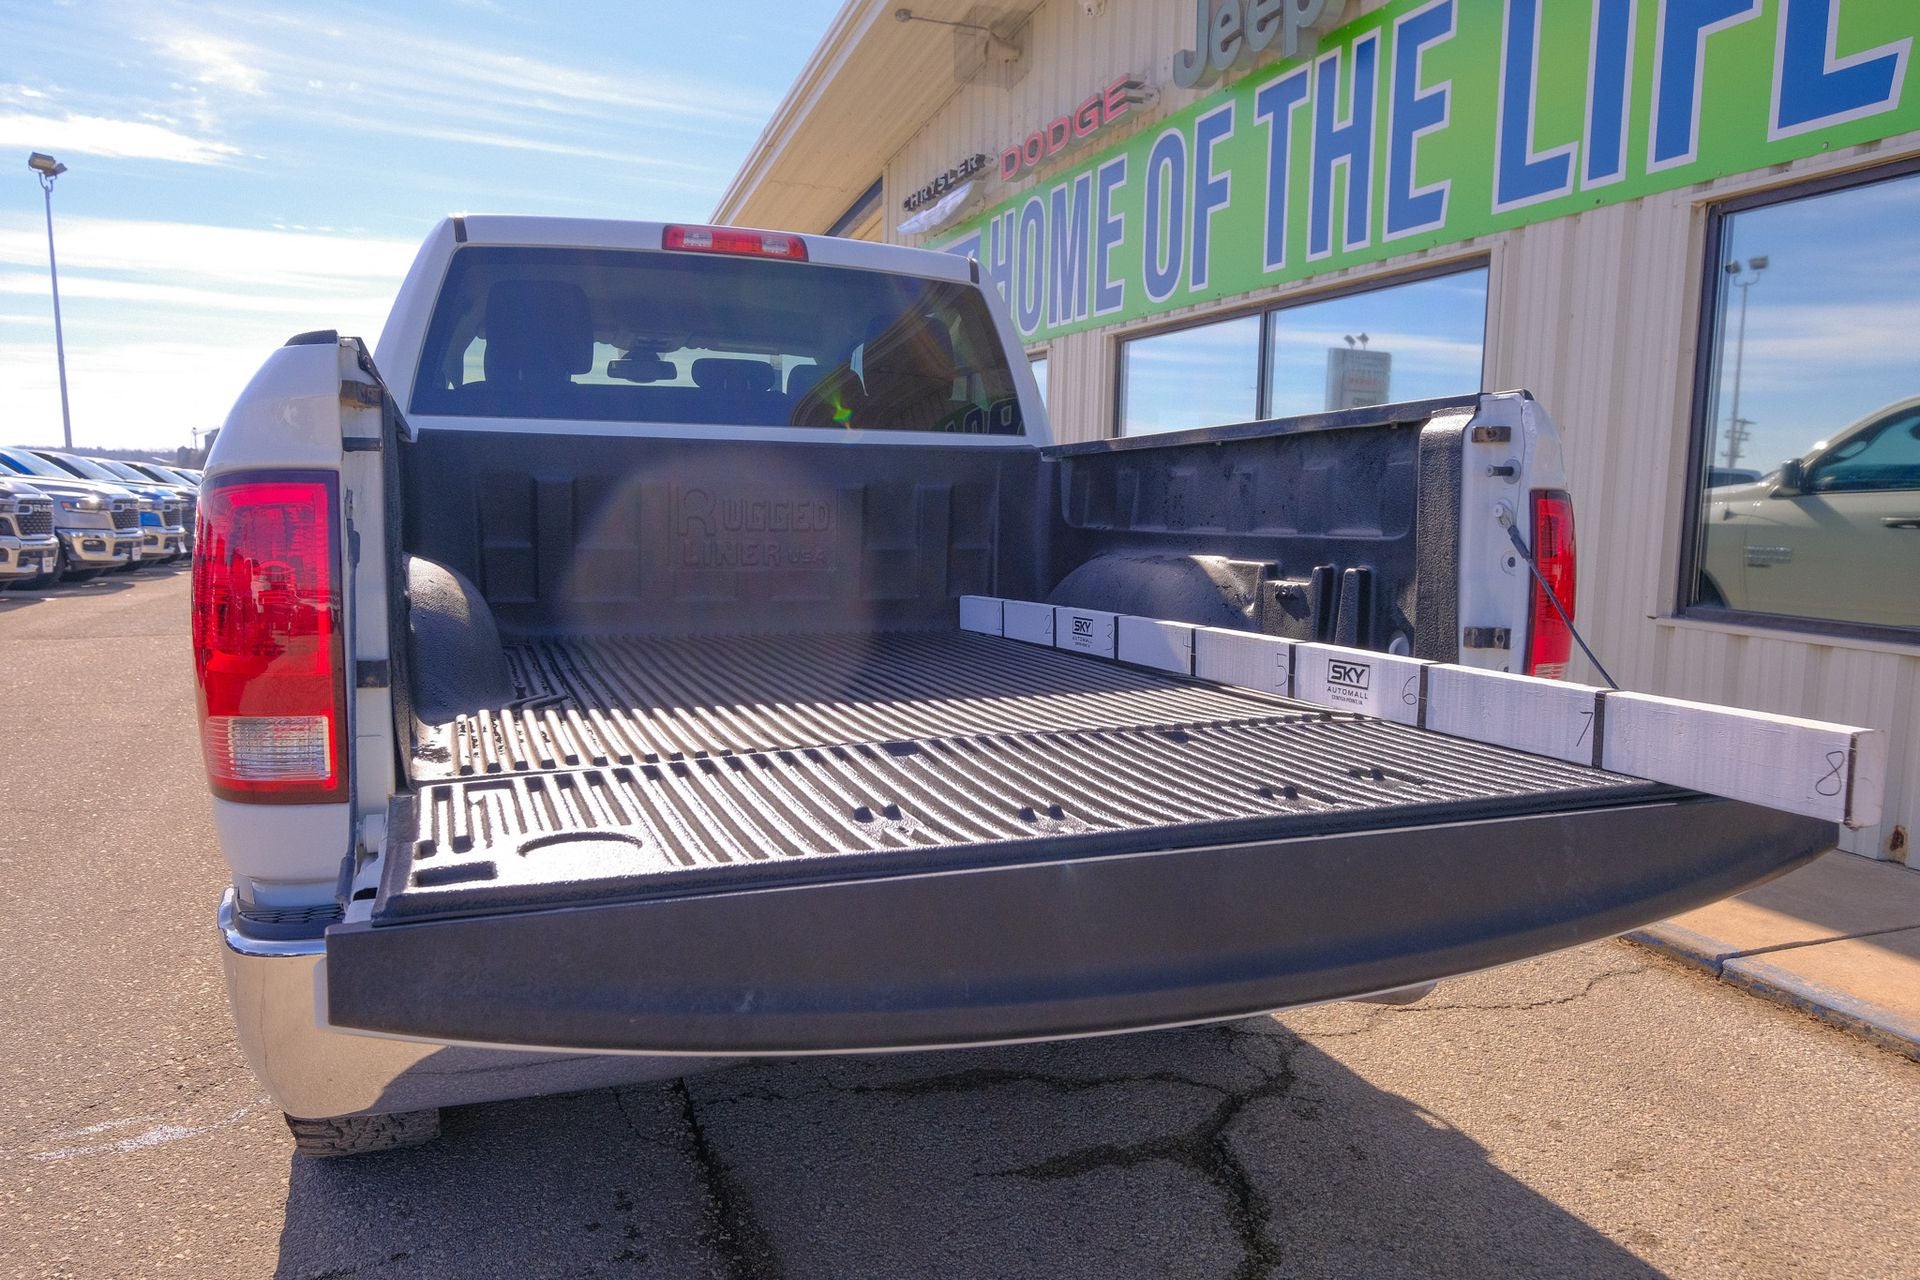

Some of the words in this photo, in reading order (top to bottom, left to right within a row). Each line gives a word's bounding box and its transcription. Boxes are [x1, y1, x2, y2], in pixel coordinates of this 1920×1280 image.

[1000, 73, 1131, 181] DODGE
[989, 153, 1128, 336] HOME
[1142, 99, 1236, 304] OF
[1254, 0, 1458, 273] THE
[676, 487, 831, 537] RUGGED
[683, 539, 783, 567] LINER
[1043, 614, 1052, 635] 2
[1073, 620, 1092, 633] SKY
[1103, 623, 1113, 651] 3
[1275, 653, 1288, 688] 5
[1330, 664, 1366, 684] SKY
[1327, 685, 1369, 700] AUTOMALL
[1402, 675, 1418, 706] 6
[1576, 711, 1594, 747] 7
[1815, 750, 1845, 797] 8
